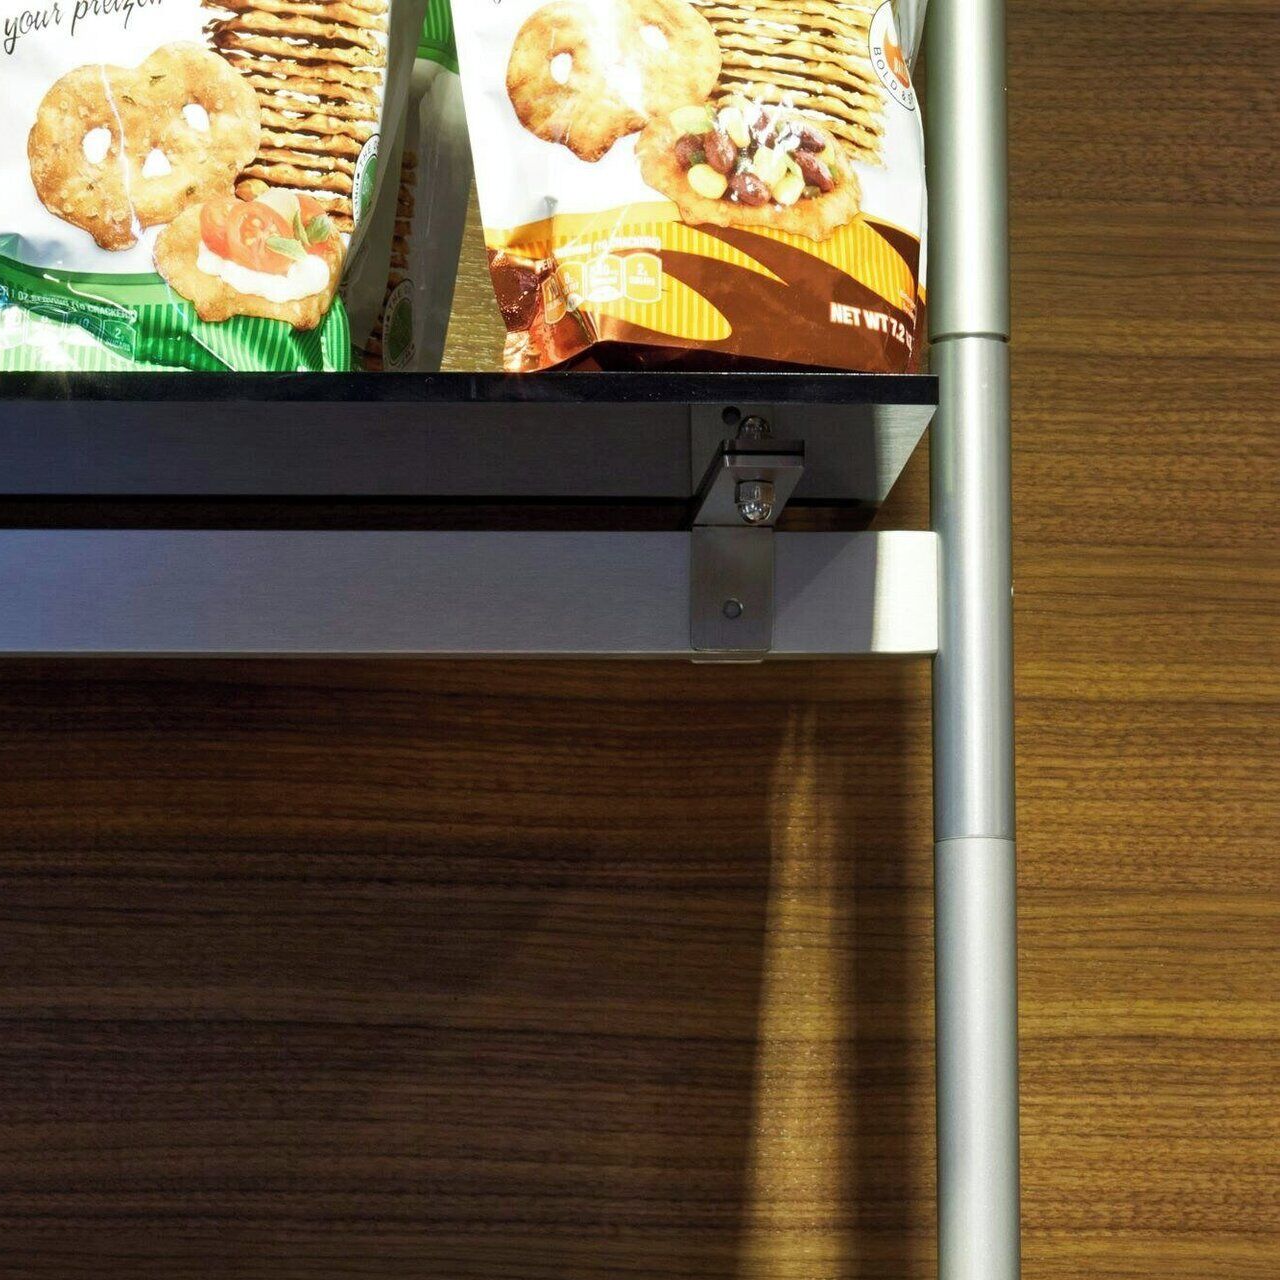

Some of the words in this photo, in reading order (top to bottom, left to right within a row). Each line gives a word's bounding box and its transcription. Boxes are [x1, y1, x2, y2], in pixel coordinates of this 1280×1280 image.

[3, 1, 64, 55] your
[830, 301, 861, 327] NET
[863, 309, 889, 333] WT
